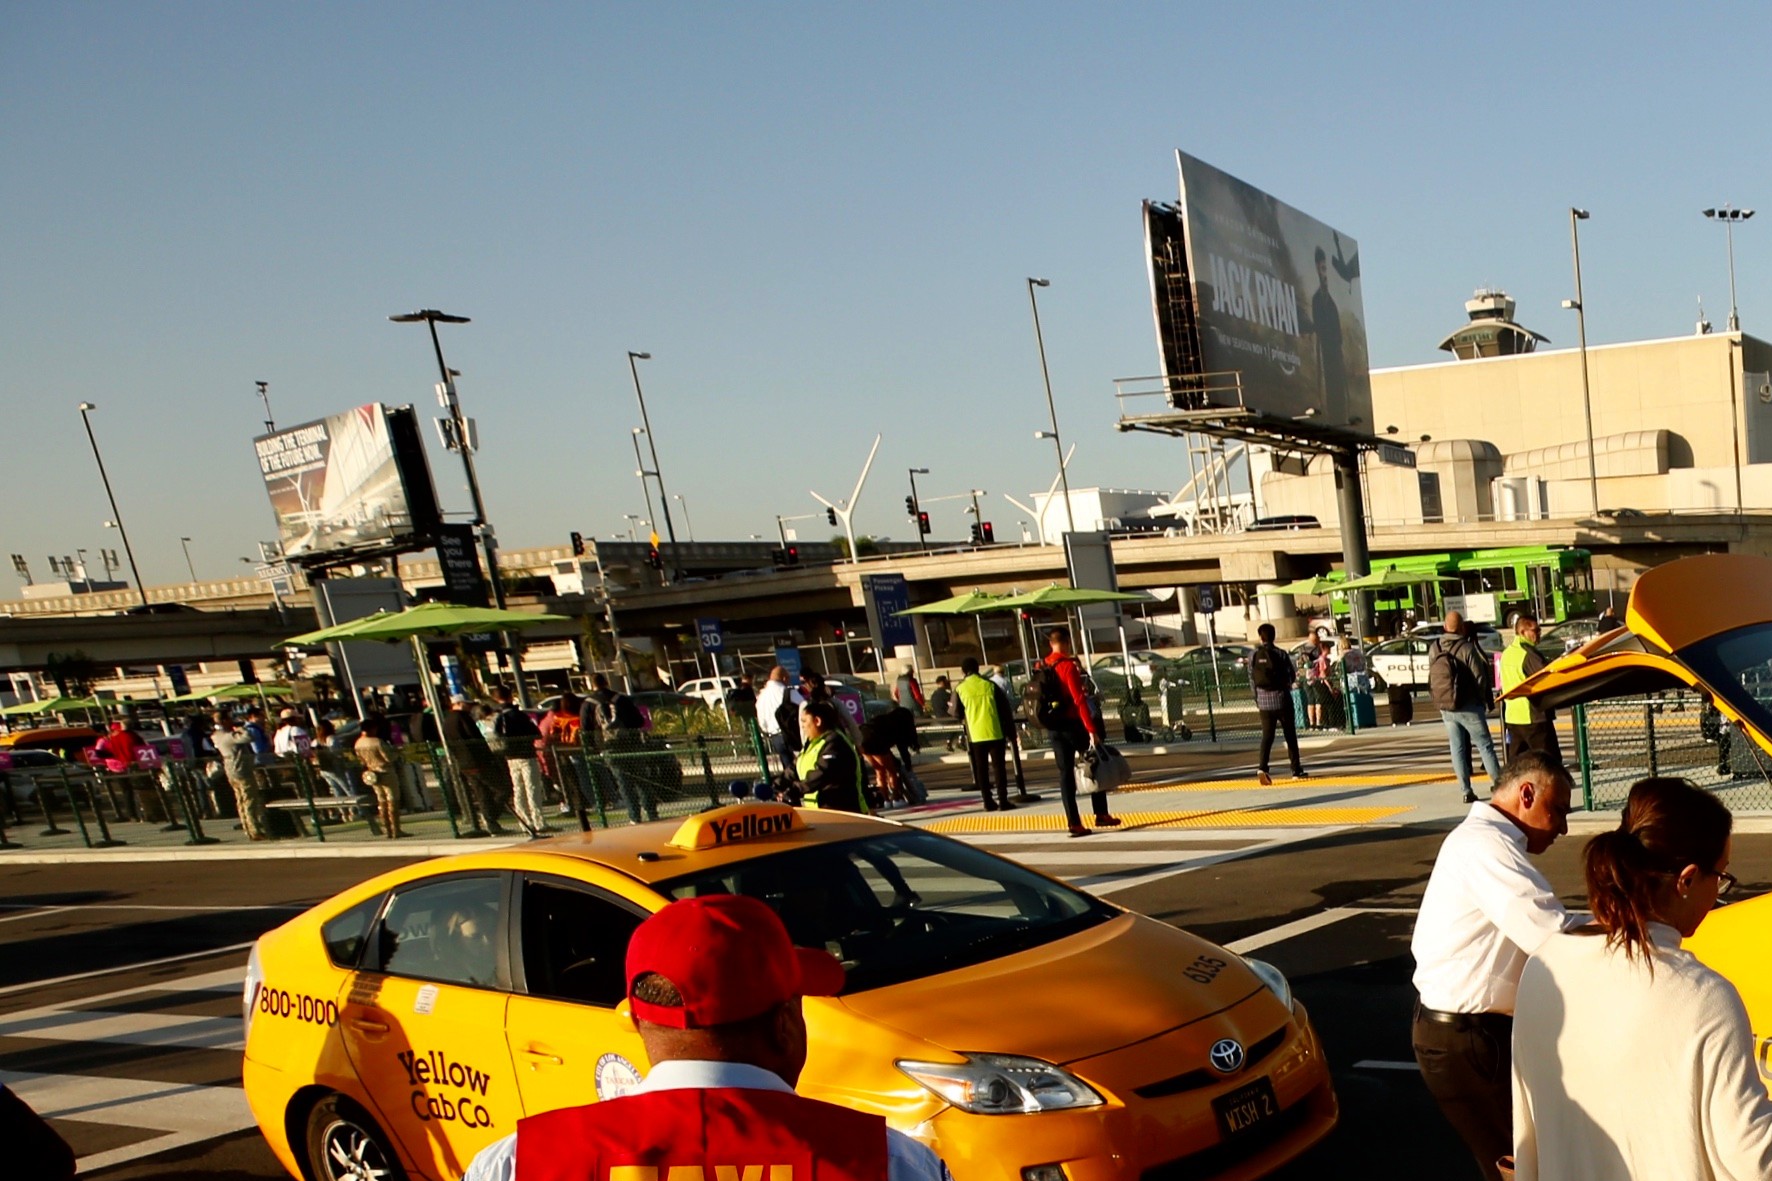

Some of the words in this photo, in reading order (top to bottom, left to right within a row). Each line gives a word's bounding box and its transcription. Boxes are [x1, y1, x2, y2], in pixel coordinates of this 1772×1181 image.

[1209, 252, 1256, 323] JACK
[1255, 271, 1300, 337] RYAN
[268, 452, 283, 471] THE
[702, 633, 722, 648] 3D
[138, 749, 157, 761] 21
[709, 812, 793, 843] Yellow
[259, 986, 338, 1028] 800-1000
[397, 1050, 490, 1097] Yellow
[1225, 1100, 1259, 1132] WISH
[1261, 1095, 1273, 1116] 2
